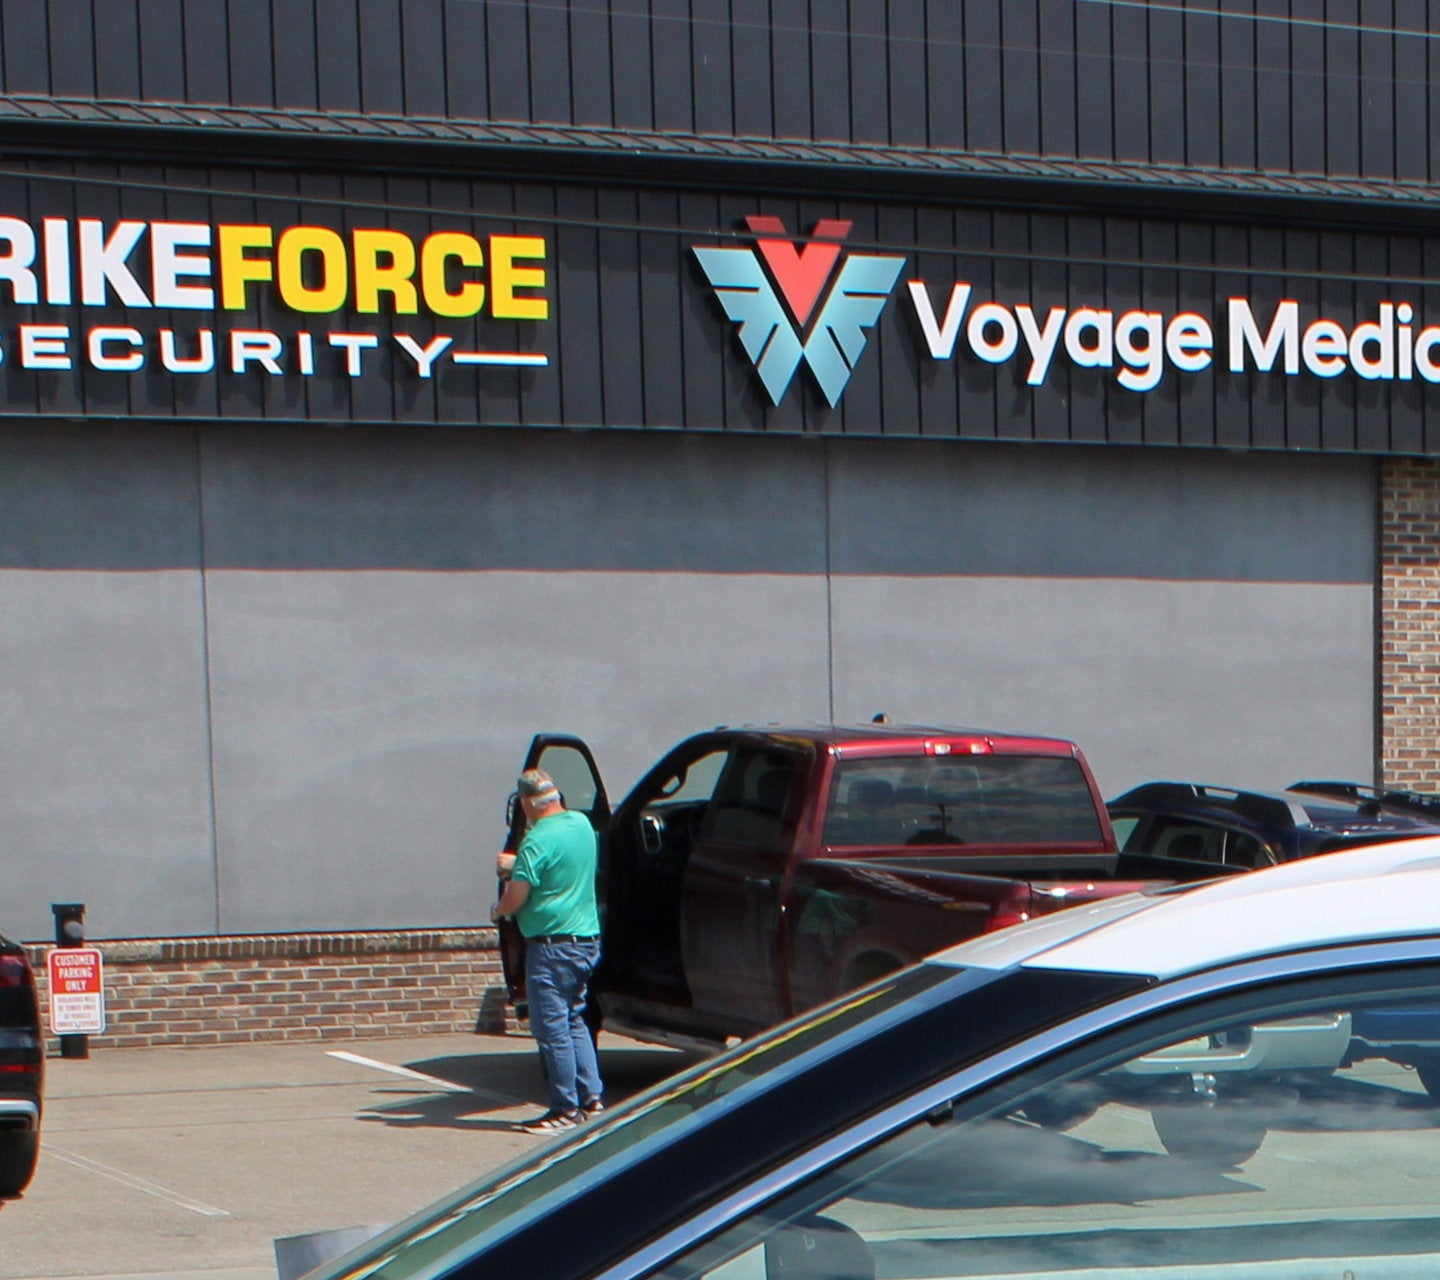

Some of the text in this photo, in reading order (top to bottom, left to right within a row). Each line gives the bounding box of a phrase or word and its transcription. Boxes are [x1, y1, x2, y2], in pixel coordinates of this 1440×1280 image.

[906, 280, 1214, 393] Voyage
[54, 954, 96, 967] CUSTOMER
[58, 967, 94, 979] PARKING
[64, 980, 87, 991] ONLY
